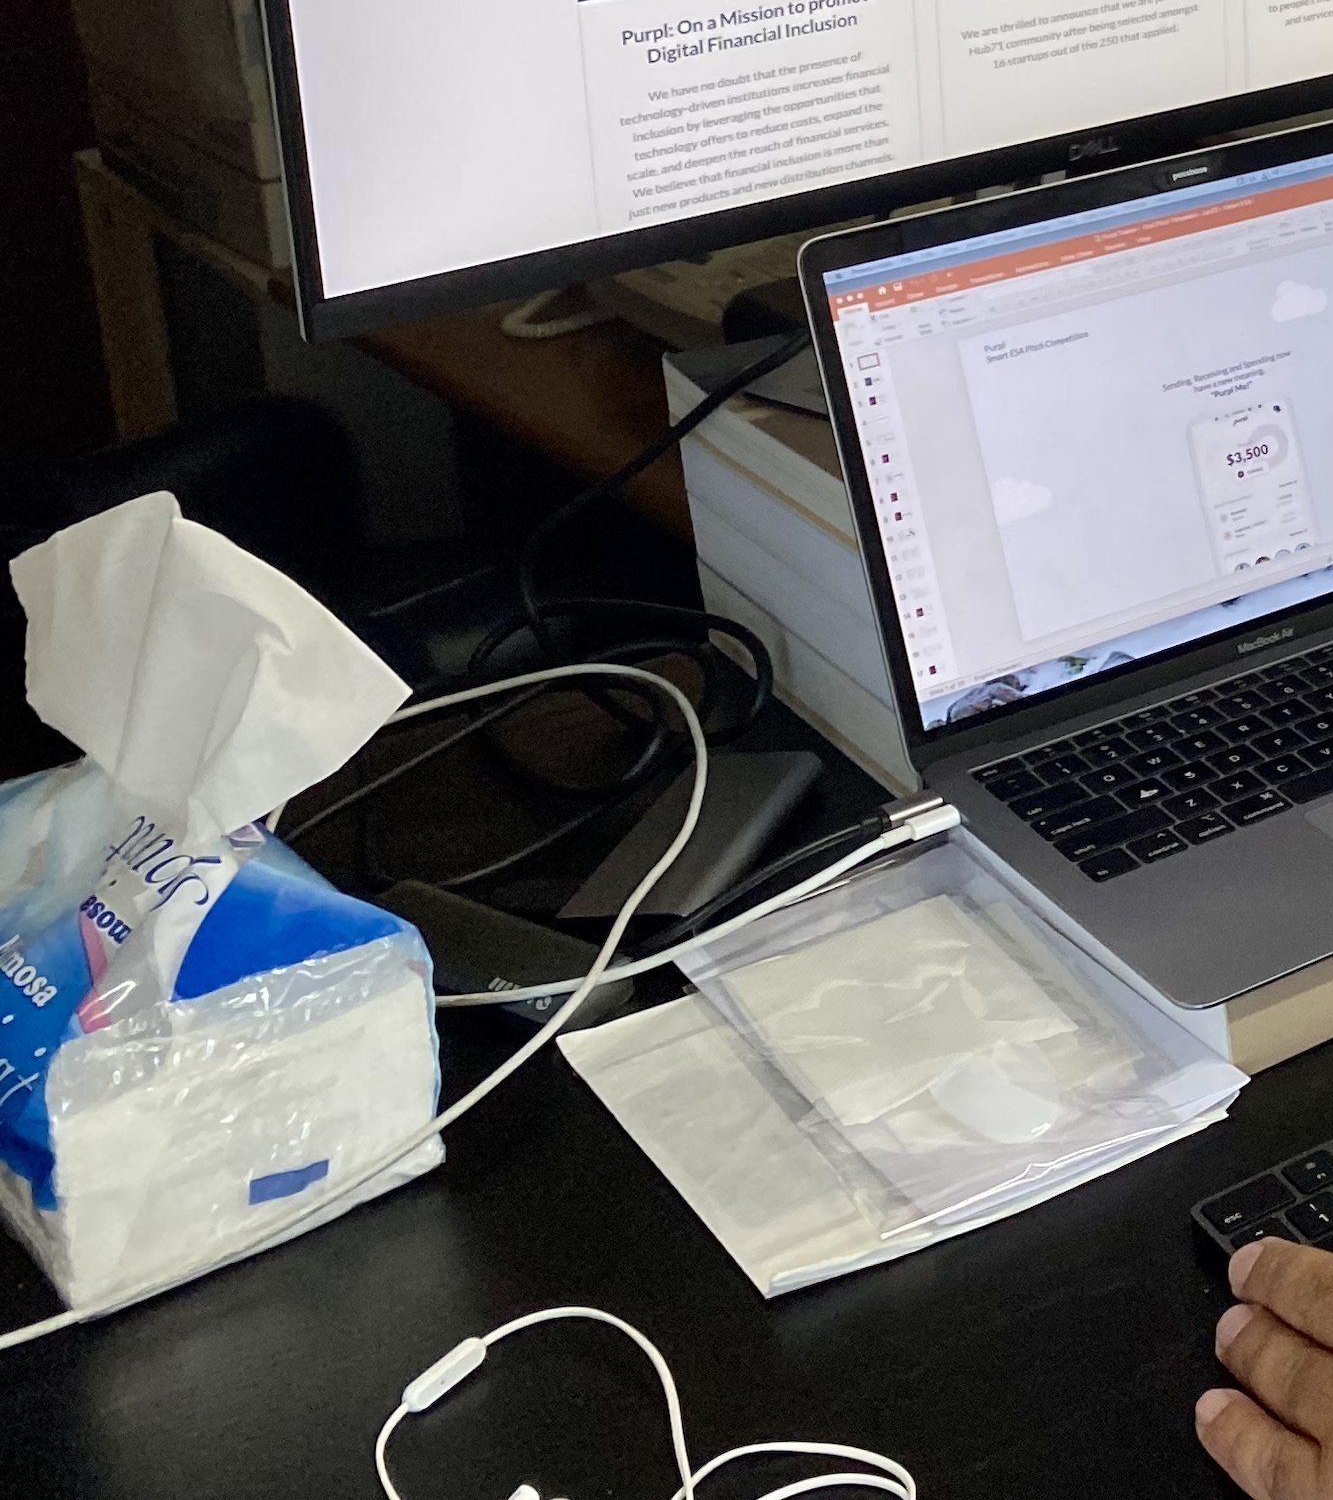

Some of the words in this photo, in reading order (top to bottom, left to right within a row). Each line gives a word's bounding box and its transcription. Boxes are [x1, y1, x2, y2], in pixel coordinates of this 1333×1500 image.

[622, 24, 673, 44] Purpl:
[677, 21, 702, 34] On
[707, 20, 716, 29] a
[720, 7, 784, 26] Mission
[788, 3, 804, 14] to
[647, 41, 703, 63] Digital
[708, 27, 781, 51] Financial
[785, 16, 857, 36] Inclusion
[960, 31, 979, 39] We
[981, 28, 998, 36] are
[1000, 19, 1036, 32] thrilled
[1050, 9, 1098, 22] announce
[1100, 3, 1119, 12] that
[1285, 16, 1301, 25] and
[993, 60, 1006, 68] 16
[1007, 53, 1048, 65] startups
[1050, 48, 1067, 56] out
[1069, 44, 1079, 53] of
[1099, 36, 1118, 47] 250
[1120, 33, 1139, 42] that
[1142, 26, 1178, 38] applied.
[619, 100, 725, 125] technology-driven
[727, 87, 790, 104] institutions
[792, 76, 843, 91] increases
[845, 65, 890, 79] financial
[647, 92, 668, 100] We
[670, 86, 698, 96] have
[700, 83, 715, 91] no
[717, 76, 751, 87] doubt
[753, 70, 775, 80] that
[778, 67, 796, 75] the
[799, 58, 848, 72] presence
[850, 52, 861, 61] of
[1226, 444, 1269, 466] $3,500
[1224, 1212, 1242, 1224] esc
